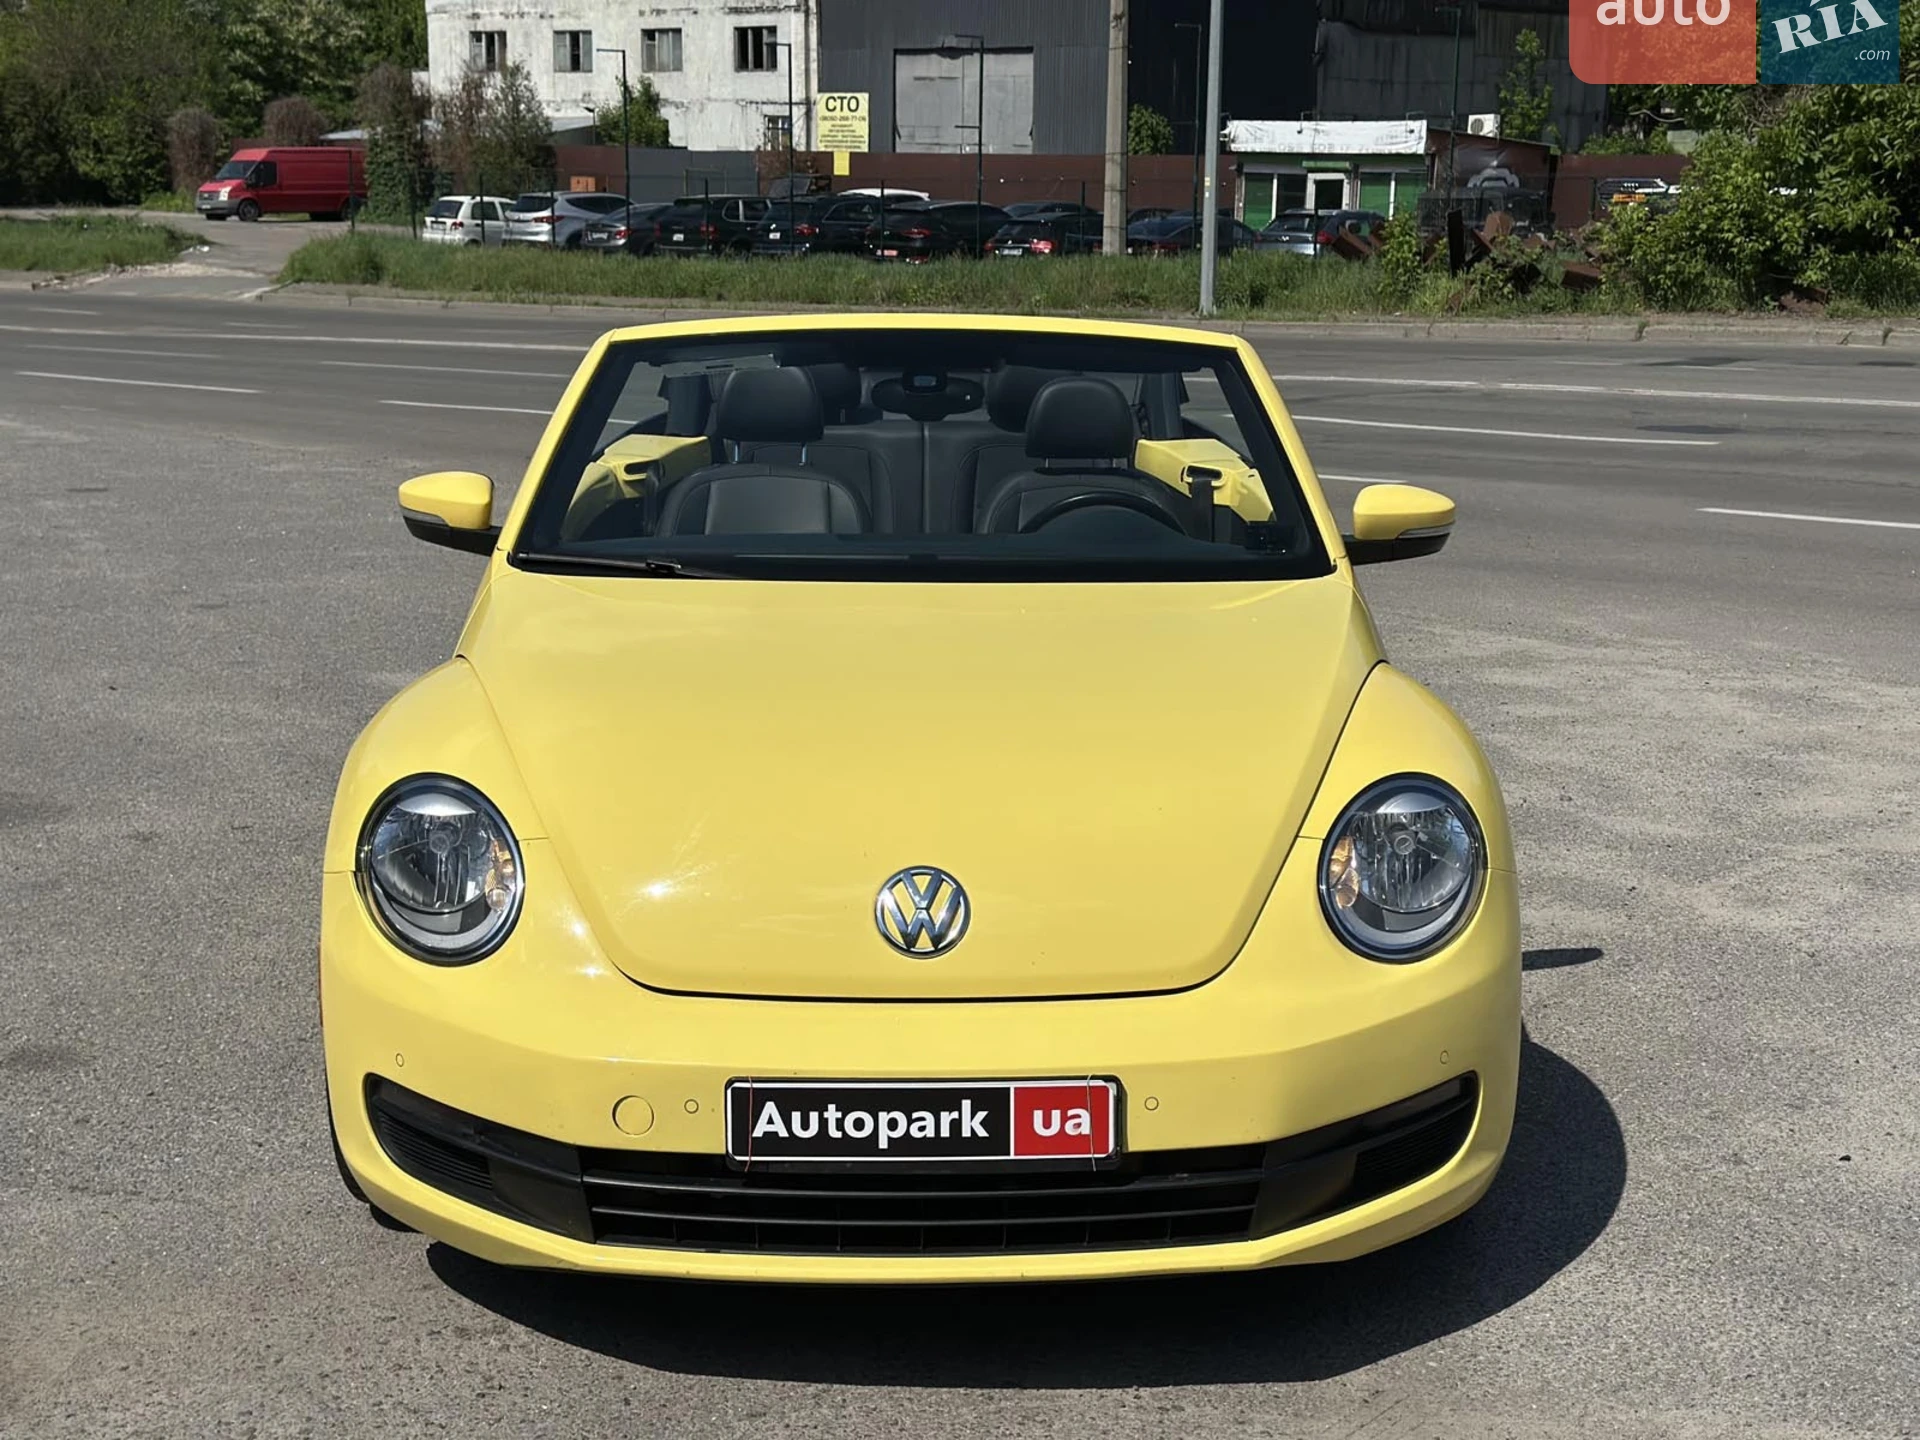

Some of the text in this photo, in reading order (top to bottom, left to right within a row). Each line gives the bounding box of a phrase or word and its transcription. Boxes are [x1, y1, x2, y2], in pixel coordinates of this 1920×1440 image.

[825, 96, 860, 112] СТО
[876, 867, 966, 954] VW
[752, 1099, 1091, 1149] Autopark ua
